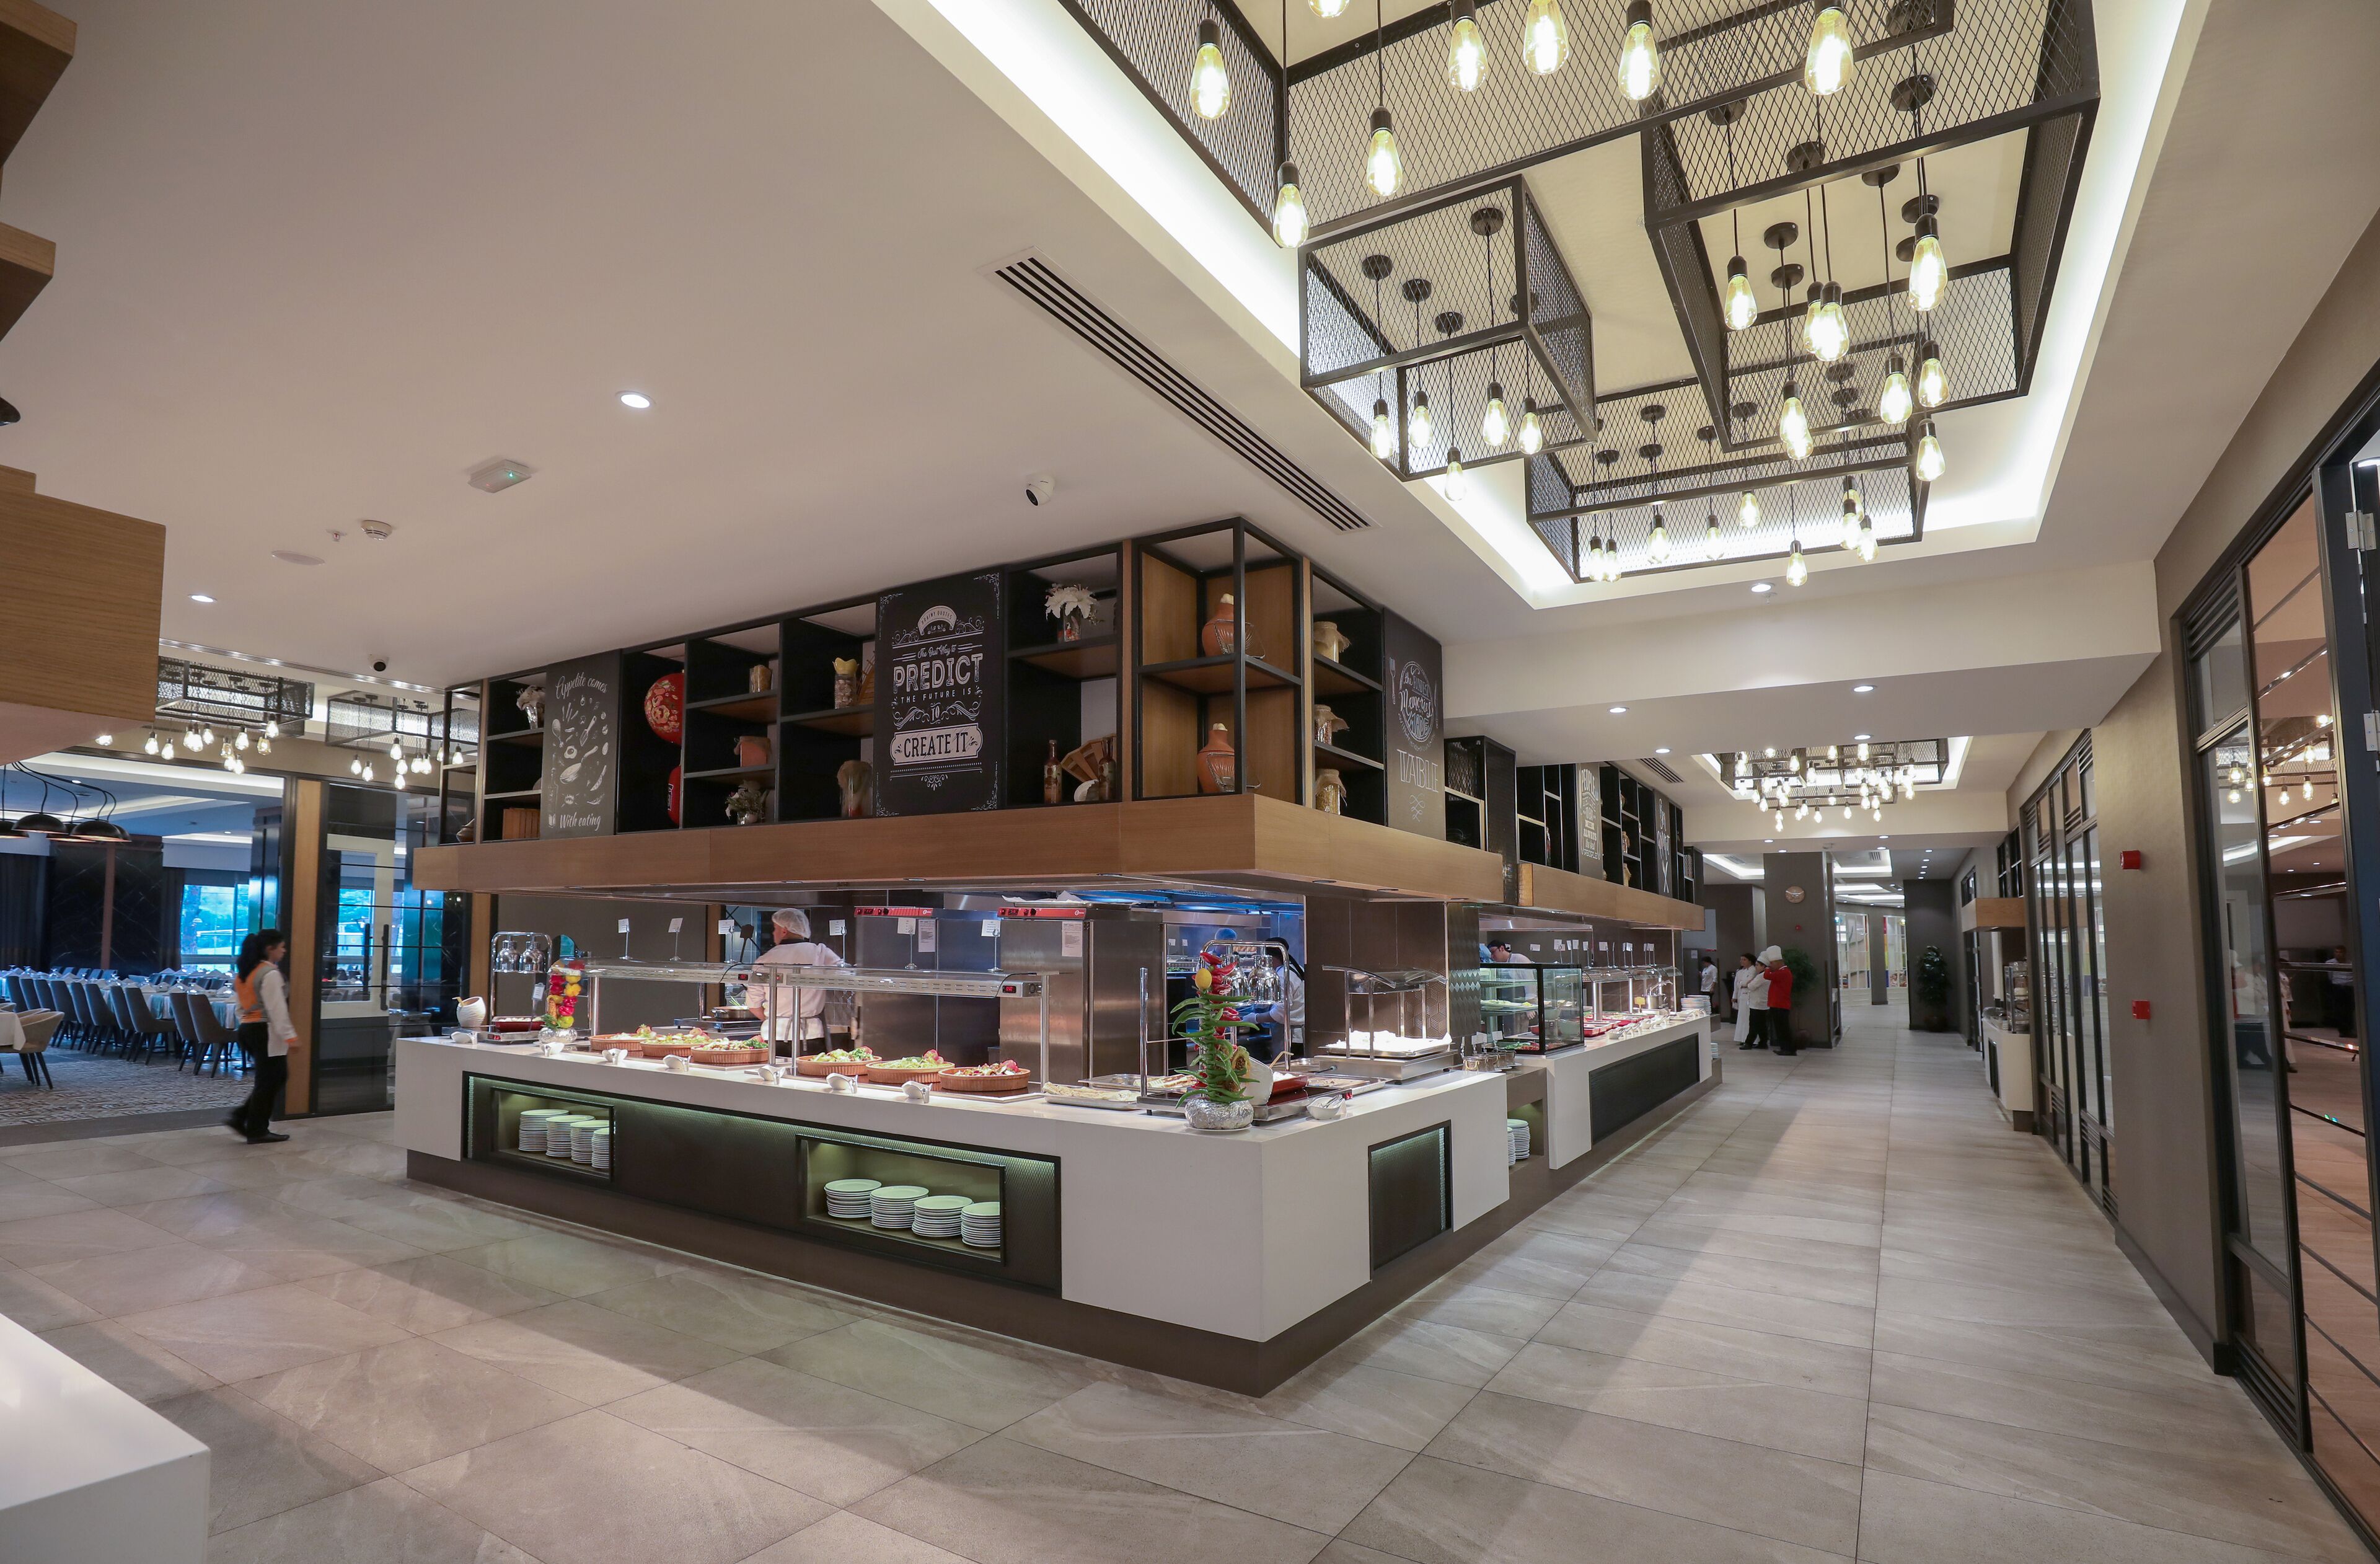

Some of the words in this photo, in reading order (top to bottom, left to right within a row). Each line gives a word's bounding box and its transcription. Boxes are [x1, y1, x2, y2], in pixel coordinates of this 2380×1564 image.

[937, 610, 953, 620] QUOTES
[917, 648, 927, 659] The
[928, 647, 938, 657] Best
[951, 645, 957, 653] to
[555, 671, 586, 700] Appetite
[587, 677, 607, 694] comes
[893, 653, 984, 694] PREDICT
[1403, 671, 1413, 686] the
[901, 695, 916, 704] THE
[923, 689, 956, 701] FUTURE
[963, 687, 972, 696] IS
[1399, 688, 1432, 718] Memories
[931, 705, 940, 722] TO
[1408, 712, 1430, 738] MADE
[904, 731, 951, 759] CREATE
[953, 731, 969, 753] IT
[1396, 749, 1439, 793] TABLE
[1581, 769, 1596, 798] PEOPLE
[560, 813, 577, 829] With
[578, 809, 602, 831] eating
[1584, 828, 1597, 841] ALWAYS
